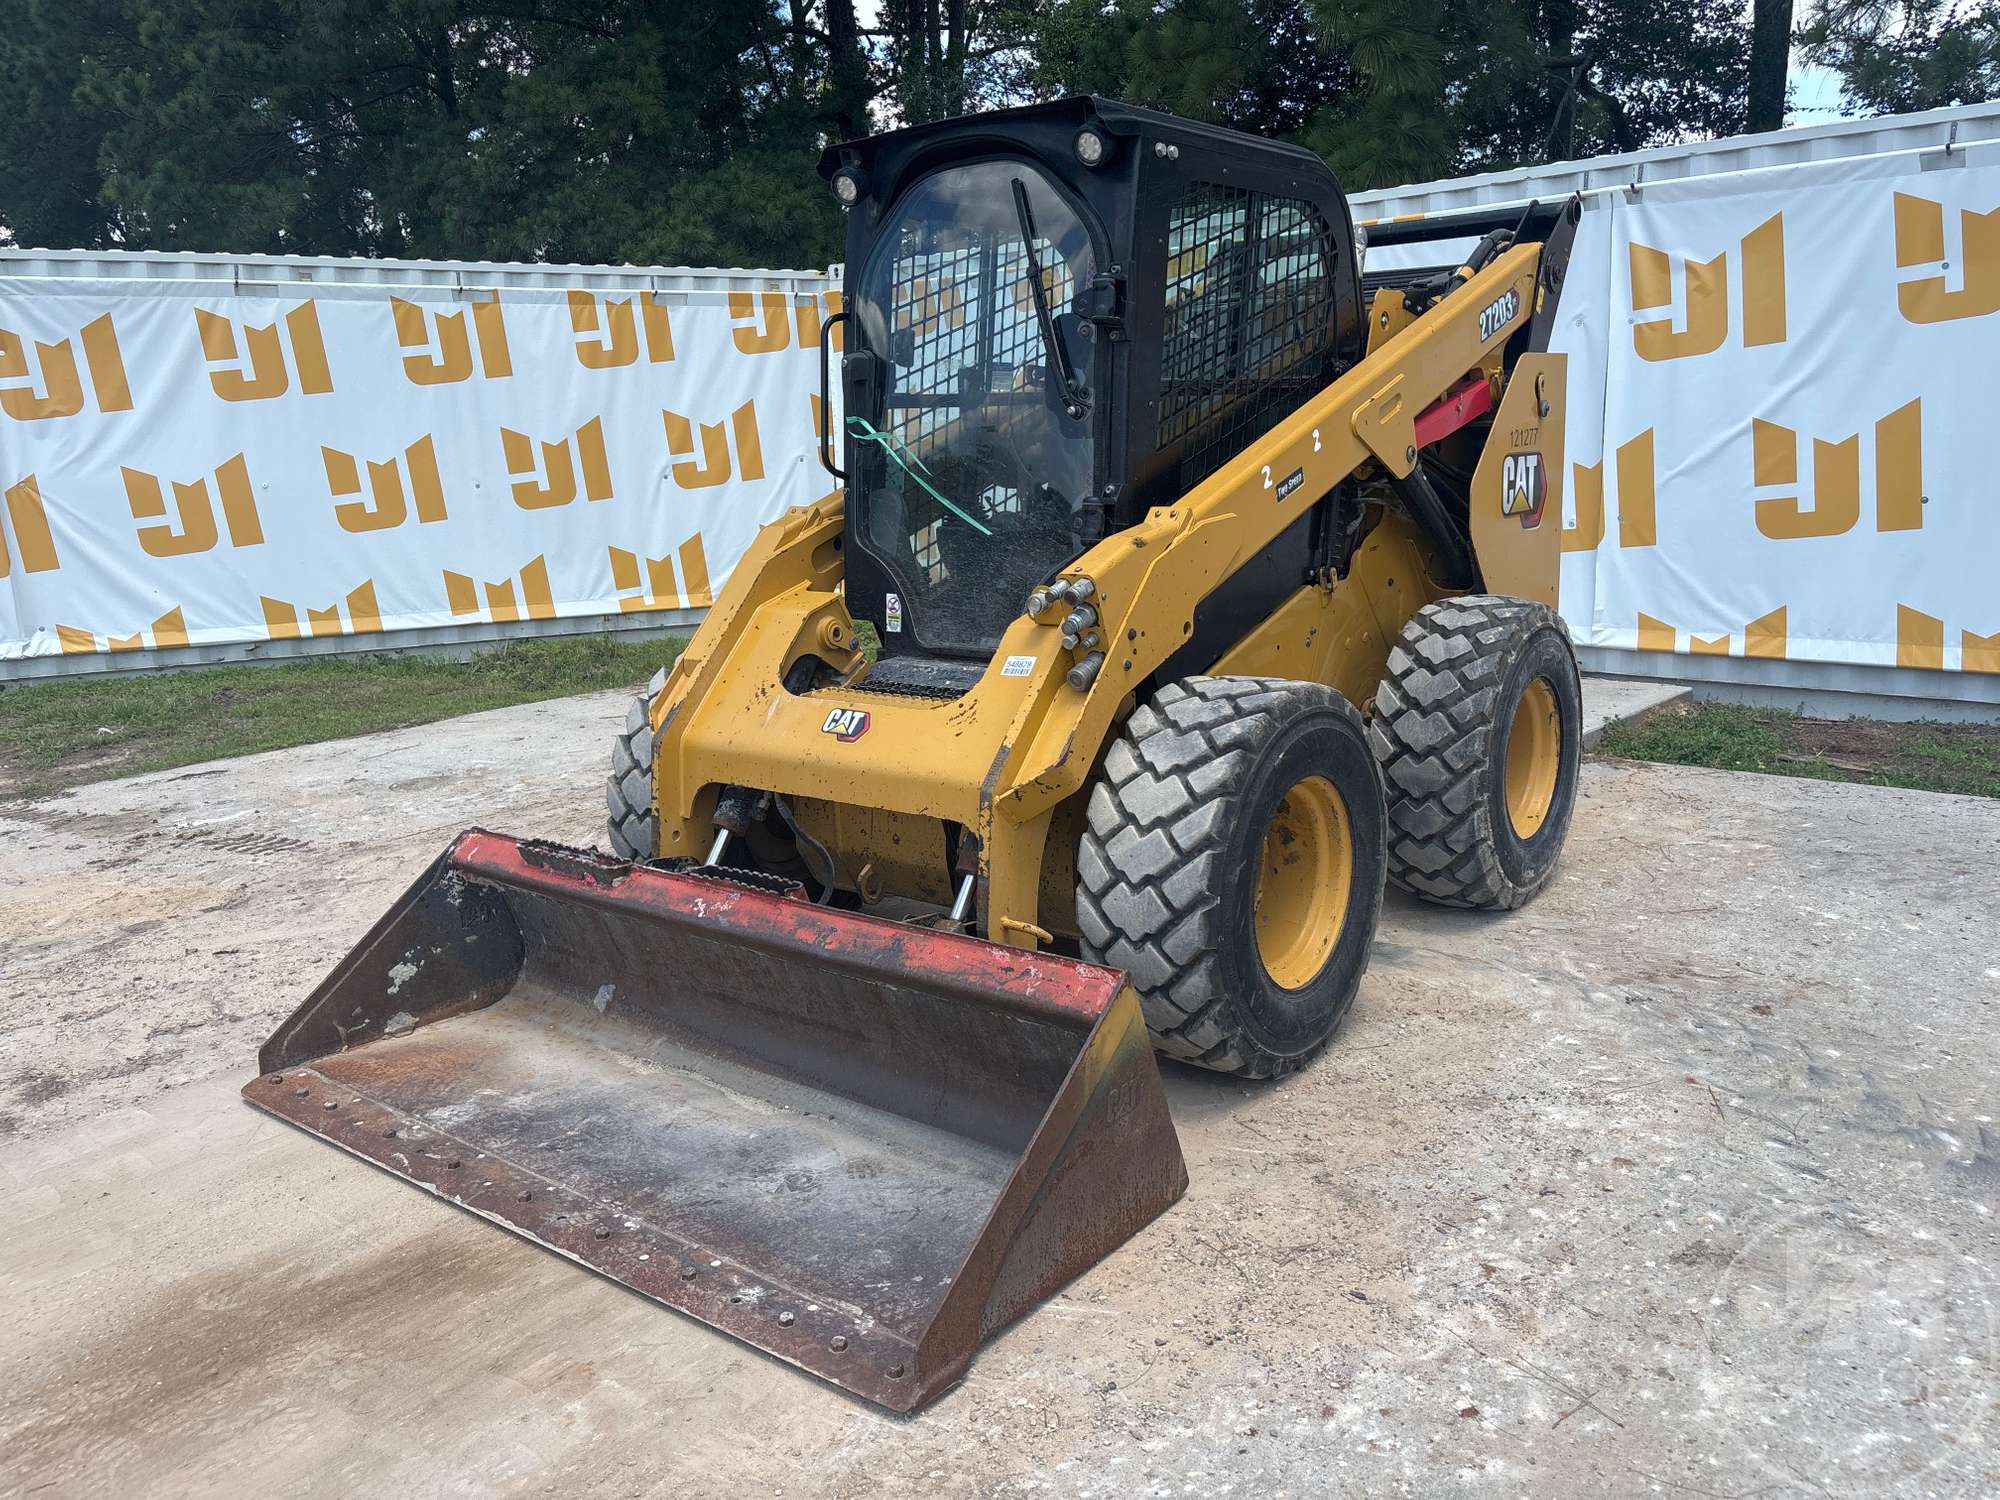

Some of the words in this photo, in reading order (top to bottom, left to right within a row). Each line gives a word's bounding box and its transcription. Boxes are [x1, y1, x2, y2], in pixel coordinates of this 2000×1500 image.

[1479, 291, 1514, 342] 272D3
[1312, 428, 1322, 453] 2
[1510, 427, 1539, 449] 121277
[1261, 465, 1273, 490] 2
[1502, 454, 1538, 514] CAT
[825, 708, 866, 736] CAT
